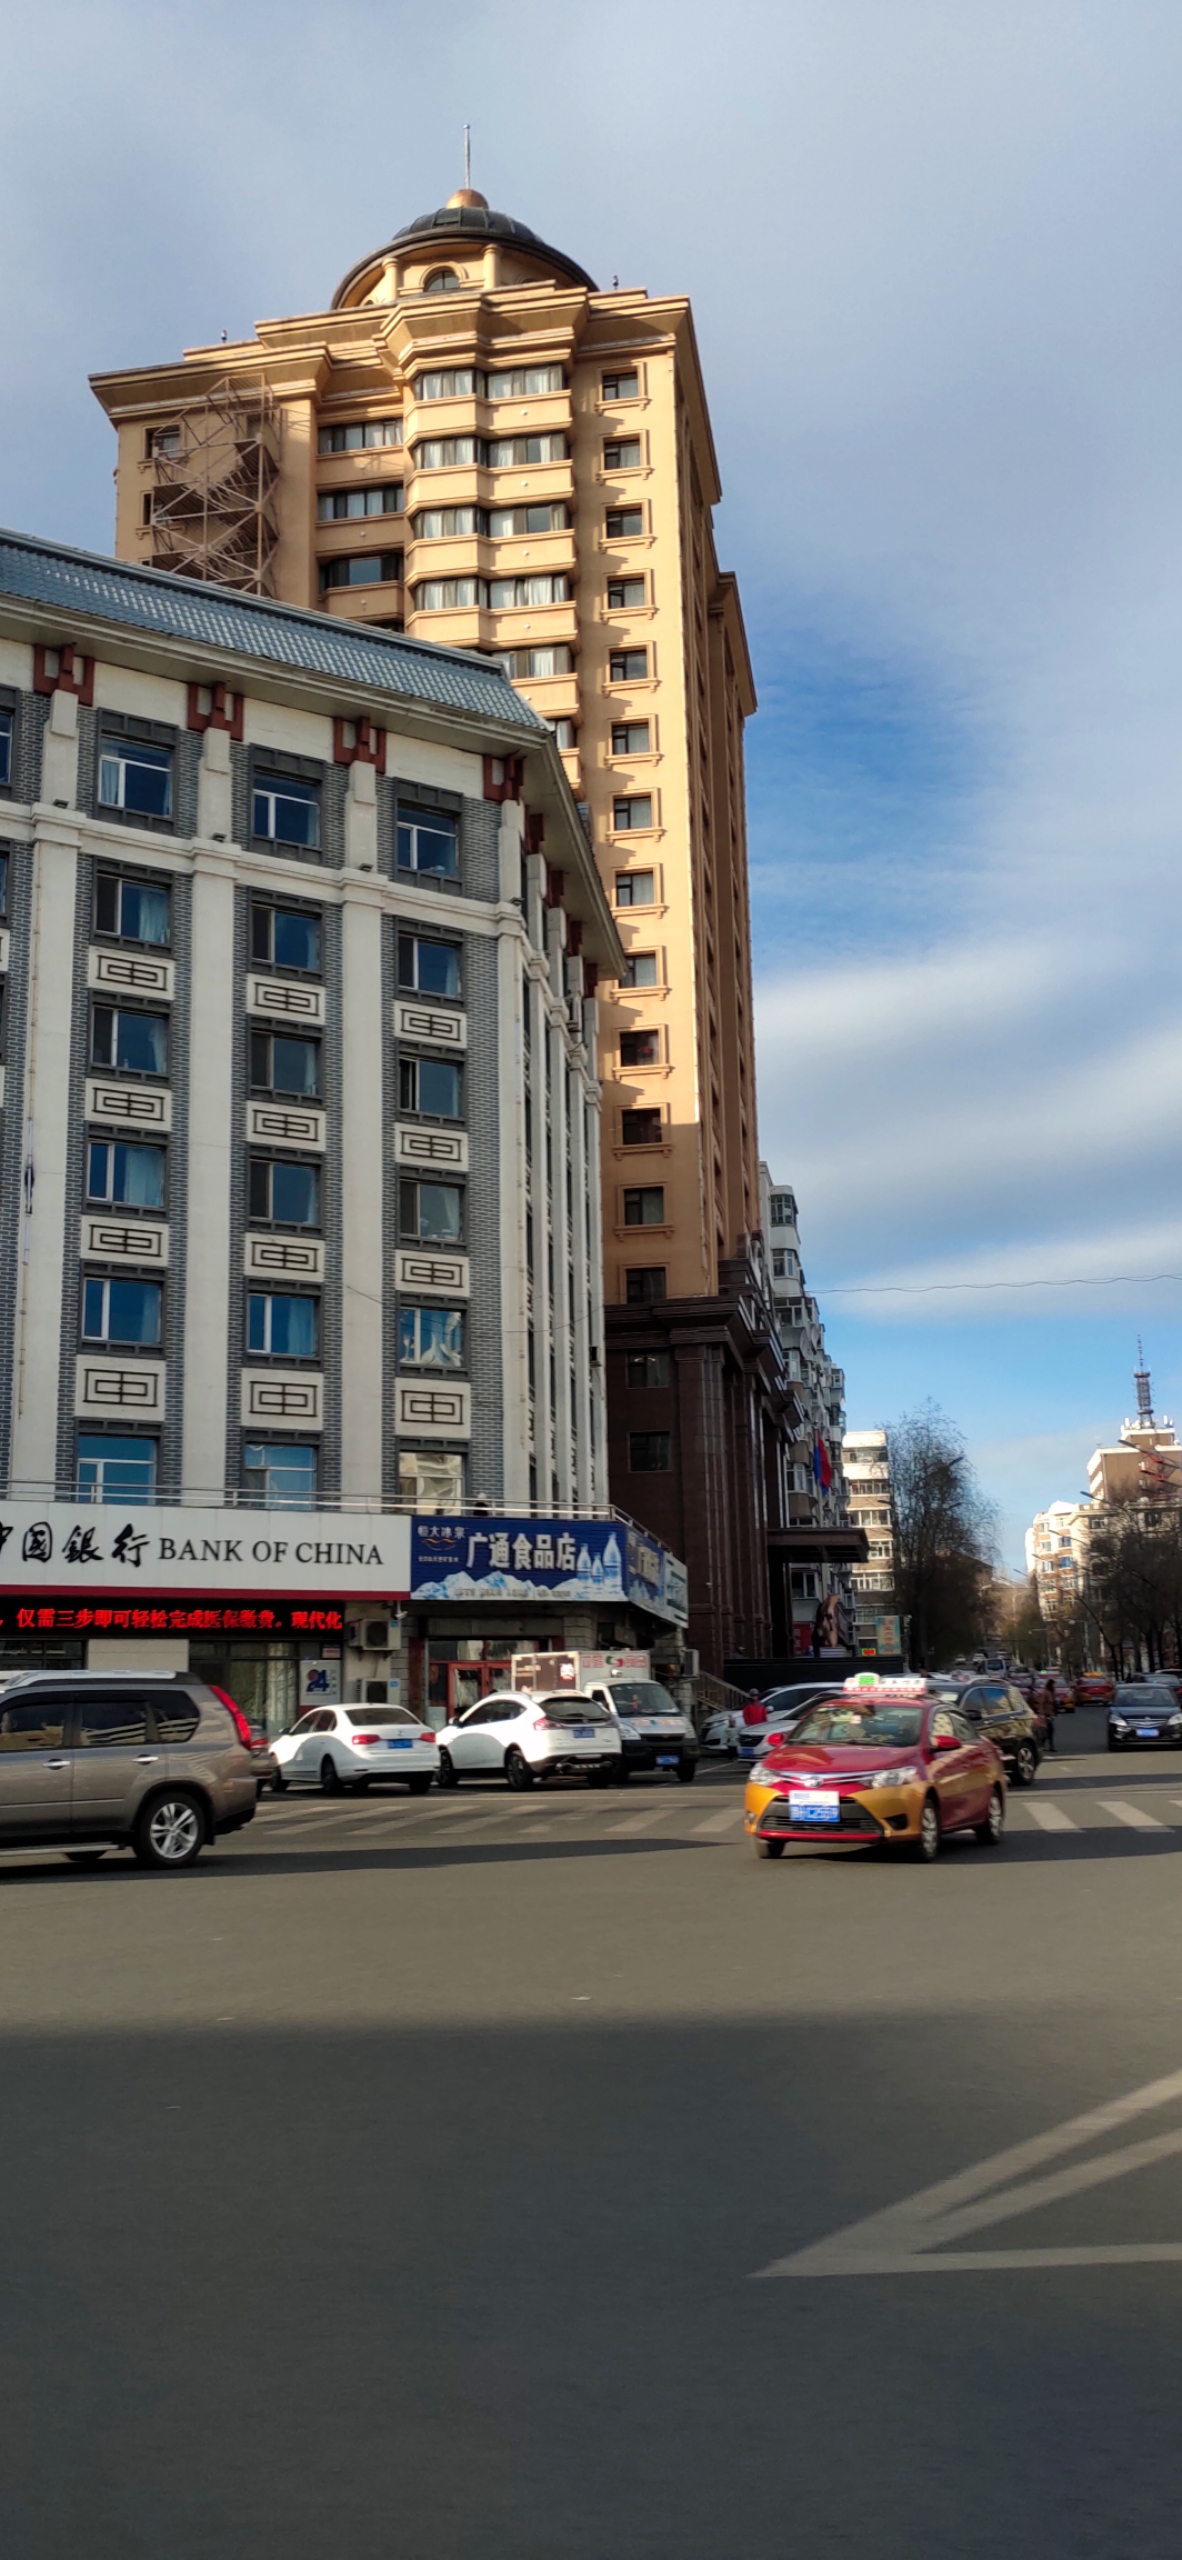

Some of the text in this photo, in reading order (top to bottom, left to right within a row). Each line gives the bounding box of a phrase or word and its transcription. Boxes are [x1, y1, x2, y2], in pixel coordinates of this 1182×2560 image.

[158, 1538, 384, 1565] BANK OF CHINA
[466, 1532, 576, 1571] 广通食品店
[306, 1669, 330, 1692] 24
